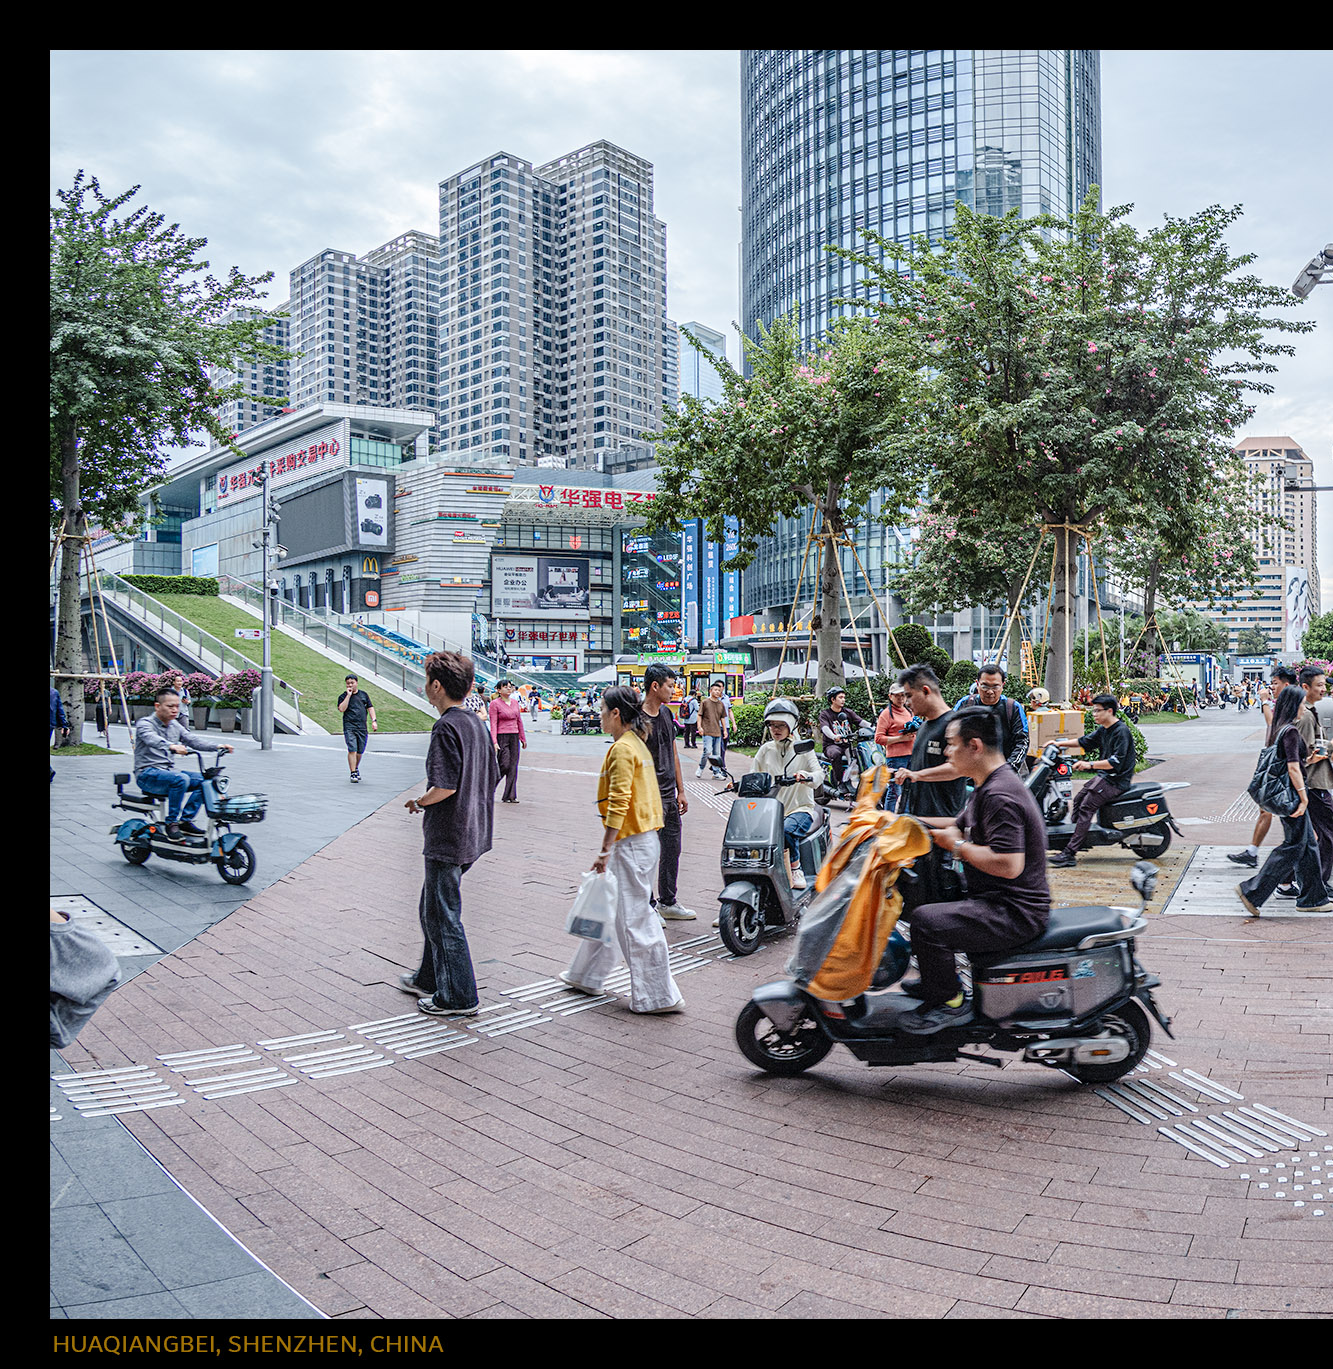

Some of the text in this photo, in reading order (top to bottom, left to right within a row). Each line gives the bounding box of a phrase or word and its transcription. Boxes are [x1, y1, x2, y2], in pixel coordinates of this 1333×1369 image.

[518, 631, 578, 641] 华强电子世界
